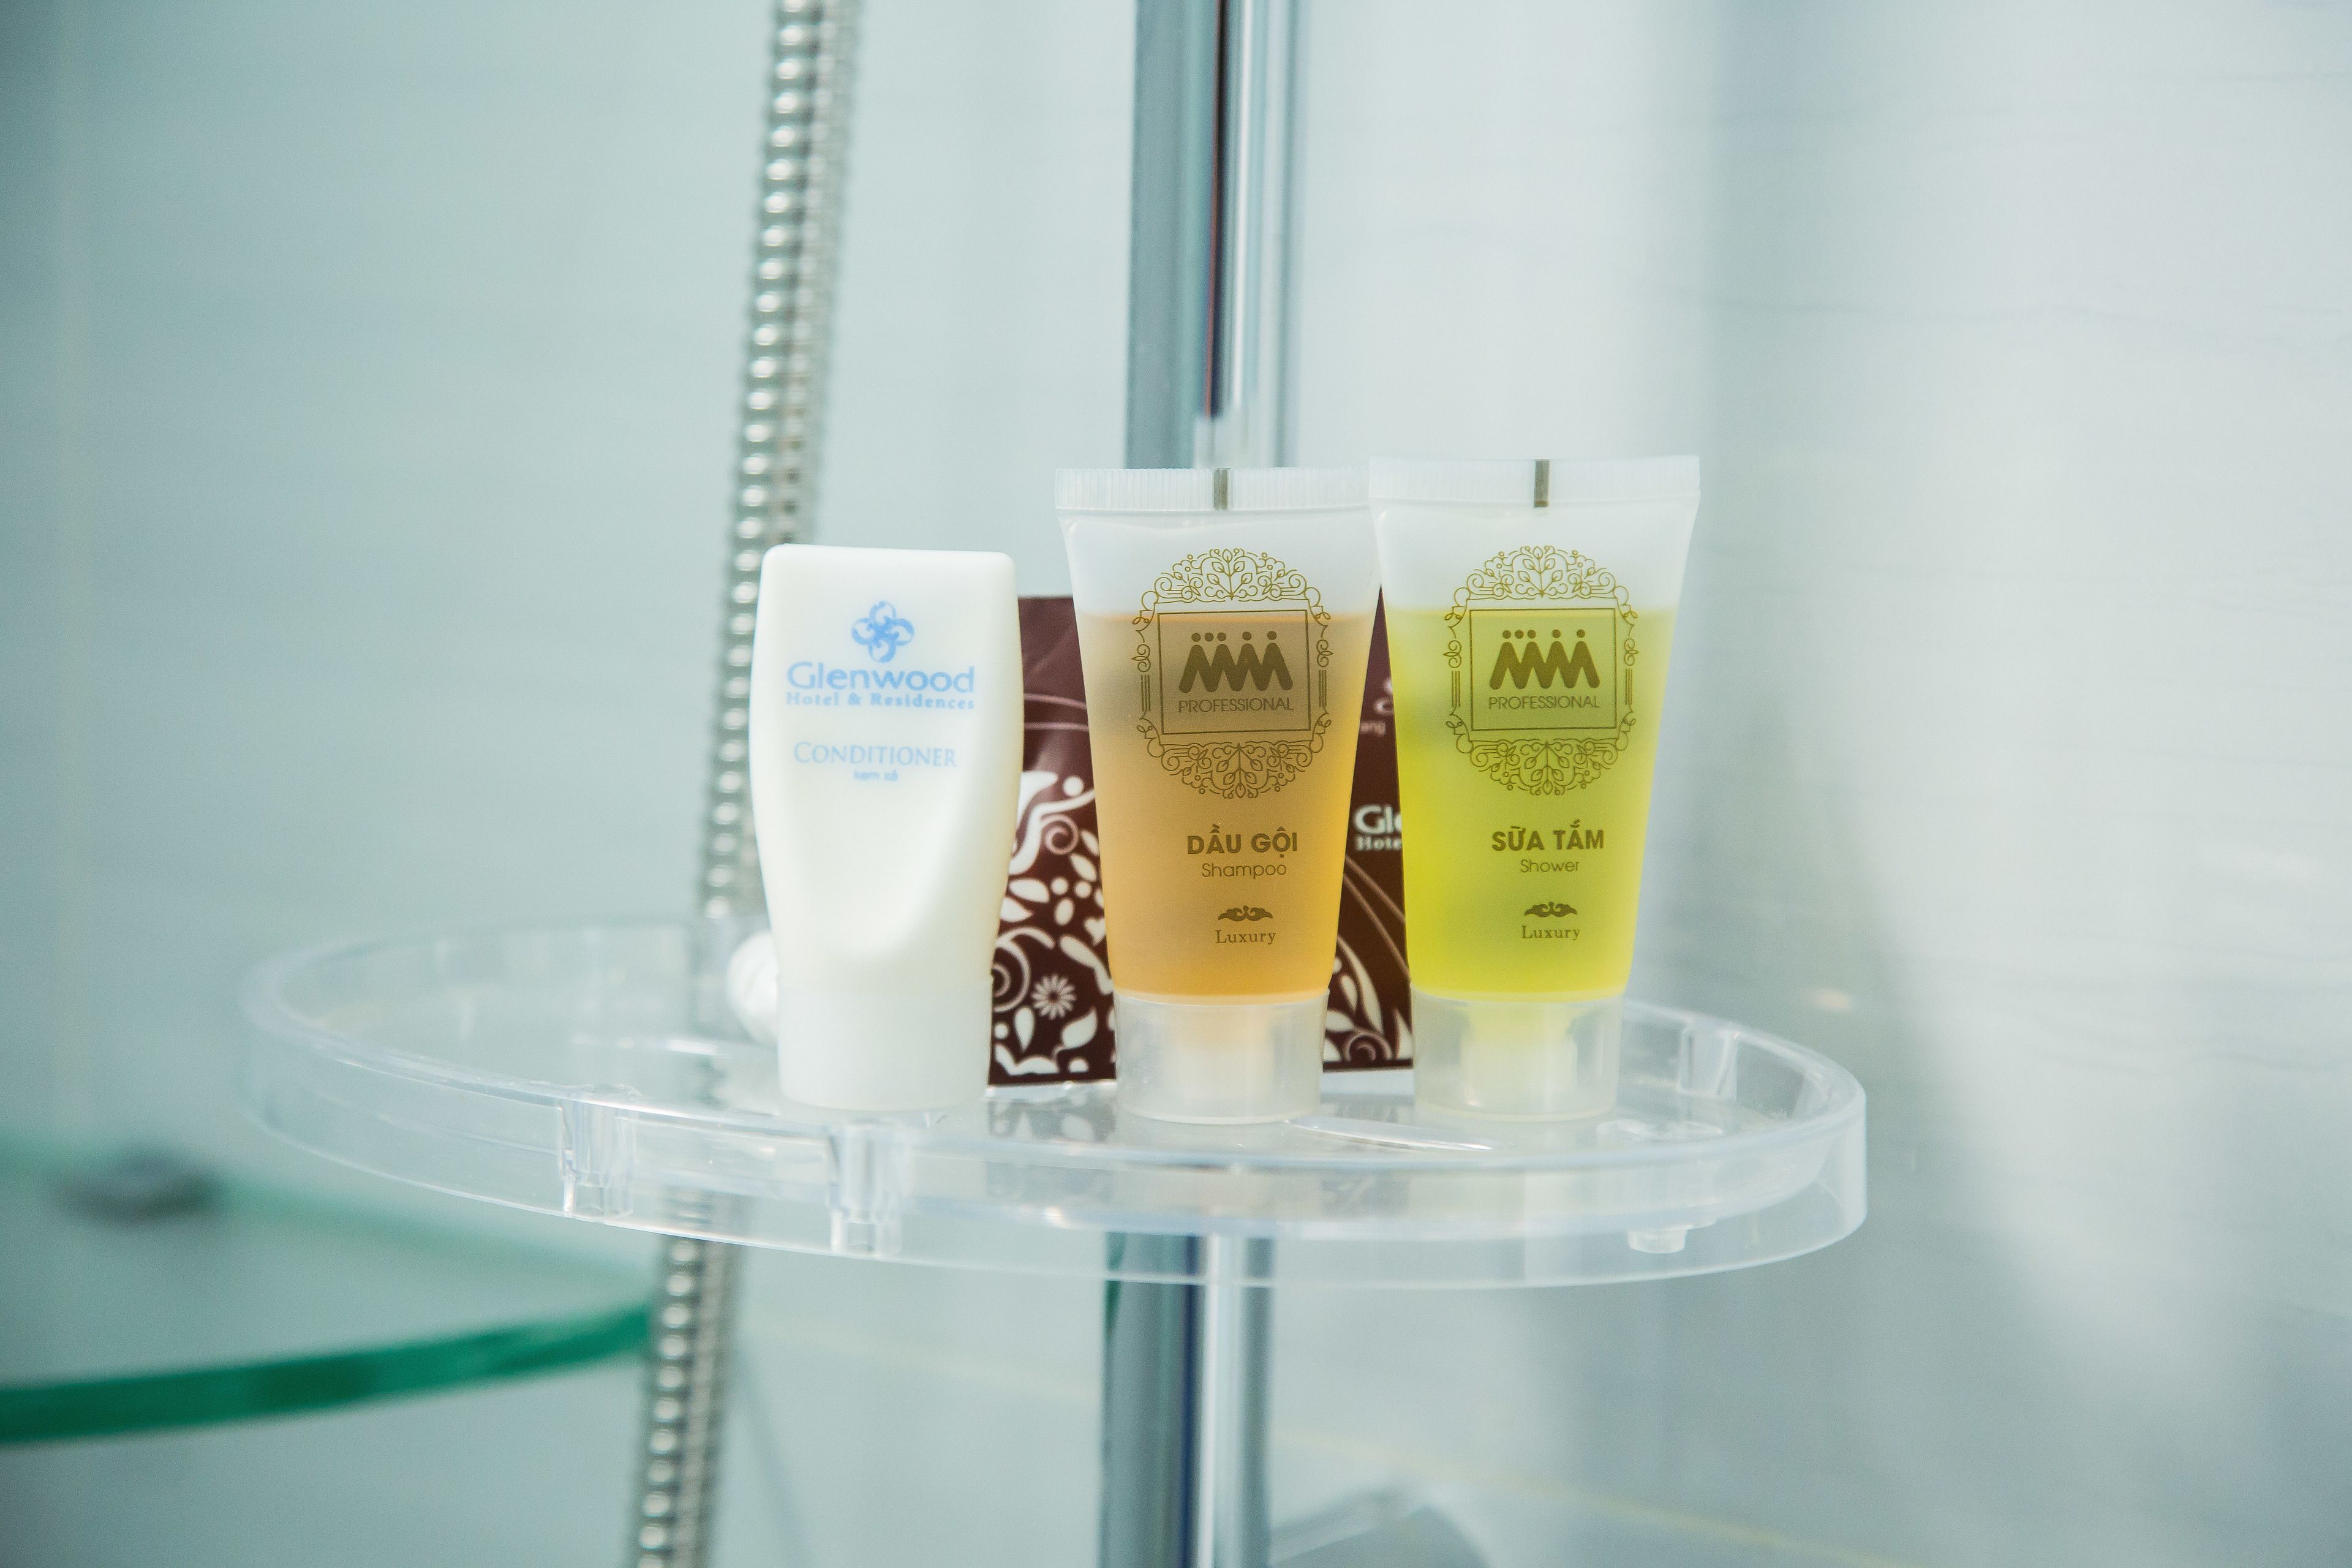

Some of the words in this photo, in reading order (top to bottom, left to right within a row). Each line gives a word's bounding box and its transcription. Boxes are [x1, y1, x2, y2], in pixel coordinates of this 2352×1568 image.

[787, 661, 975, 693] Glenwood
[786, 692, 840, 706] Hotel
[848, 693, 862, 706] &
[870, 693, 975, 710] Residences
[1178, 697, 1294, 714] PROFESSIONAL
[1488, 695, 1602, 710] PROFESSIONAL
[1187, 823, 1242, 854] DẦU
[1251, 826, 1297, 858] GỘI
[1491, 826, 1545, 851] SỮA
[1553, 818, 1604, 850] TẮM
[1202, 862, 1287, 880] Shampoo
[1520, 859, 1580, 873] Shower
[1215, 929, 1276, 945] Luxury
[1521, 925, 1580, 941] Luxury
